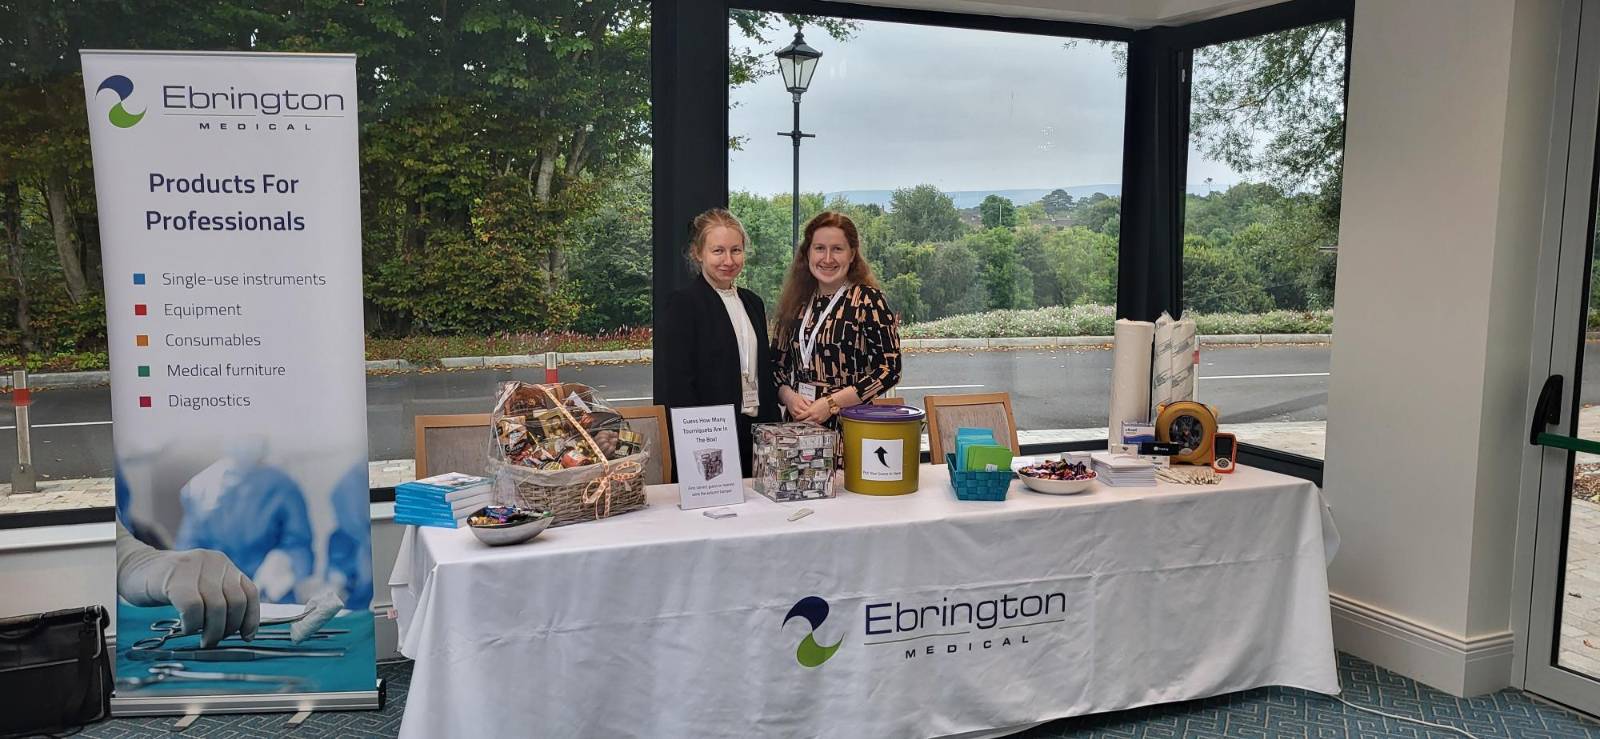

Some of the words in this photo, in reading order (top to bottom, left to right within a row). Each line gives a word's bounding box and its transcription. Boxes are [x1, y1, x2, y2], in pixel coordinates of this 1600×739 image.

[162, 85, 345, 115] Ebrington
[199, 122, 312, 131] MEDICAL
[149, 173, 256, 194] Products
[262, 174, 300, 194] For
[145, 210, 306, 231] Professionals
[162, 272, 239, 289] Single-use
[243, 272, 327, 286] instruments
[164, 303, 242, 319] Equipment
[165, 333, 261, 347] Consumables
[167, 363, 222, 377] Medical
[226, 363, 286, 377] furniture
[168, 394, 251, 411] Diagnostics
[865, 592, 1066, 636] Ebrington
[905, 635, 1029, 660] MEDICAL
